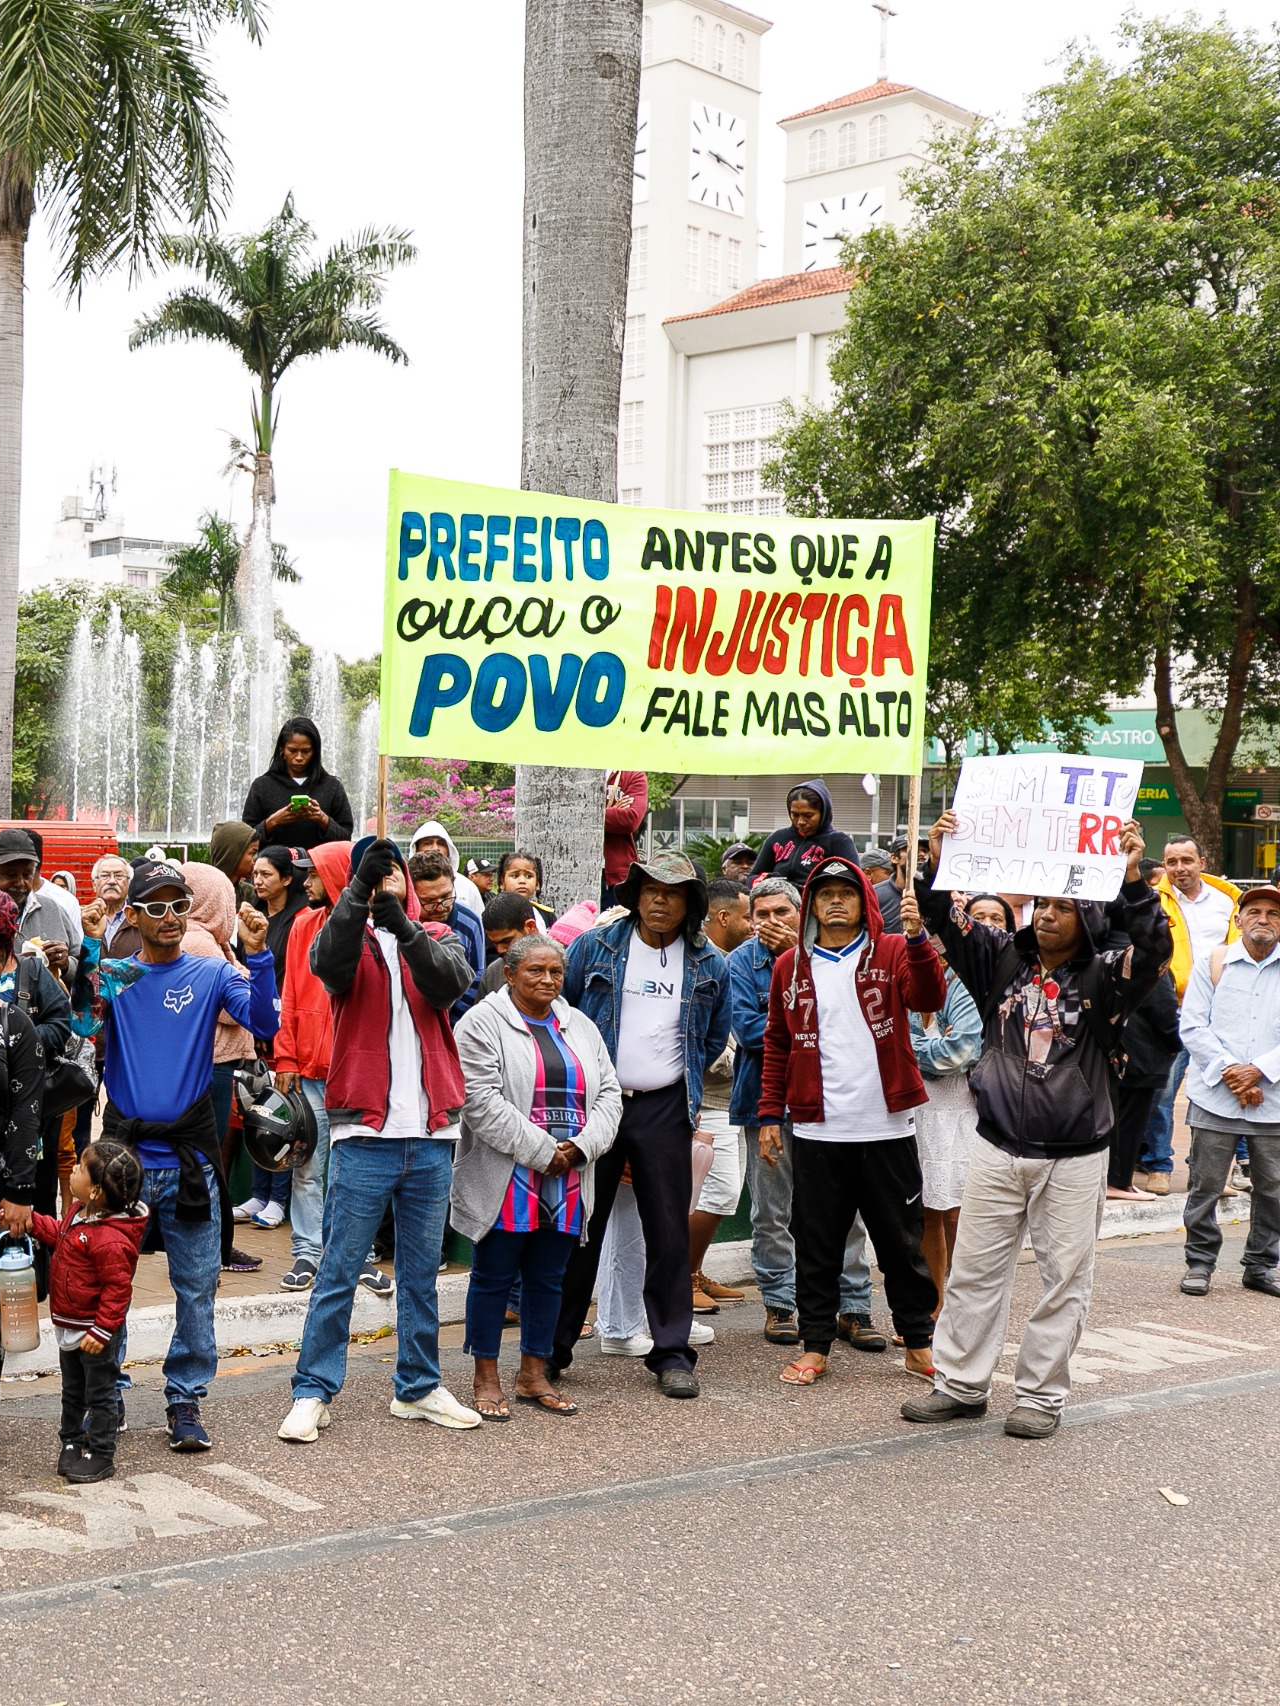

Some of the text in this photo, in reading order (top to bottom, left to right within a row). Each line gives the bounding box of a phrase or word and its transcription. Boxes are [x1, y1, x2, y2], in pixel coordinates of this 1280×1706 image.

[399, 511, 609, 583] PREFEITO
[641, 526, 892, 586] ANTES QUE A
[396, 596, 565, 645] ouça
[647, 584, 913, 689] INJUSTIÇA
[409, 651, 625, 737] POVO
[640, 686, 912, 738] FALE MAS ALTO
[970, 766, 1136, 809] SEM TETO
[951, 803, 1128, 857] SEM TERR
[945, 853, 1126, 900] SEM MEDO
[863, 987, 886, 1021] 2
[543, 1110, 580, 1123] BEIRA
